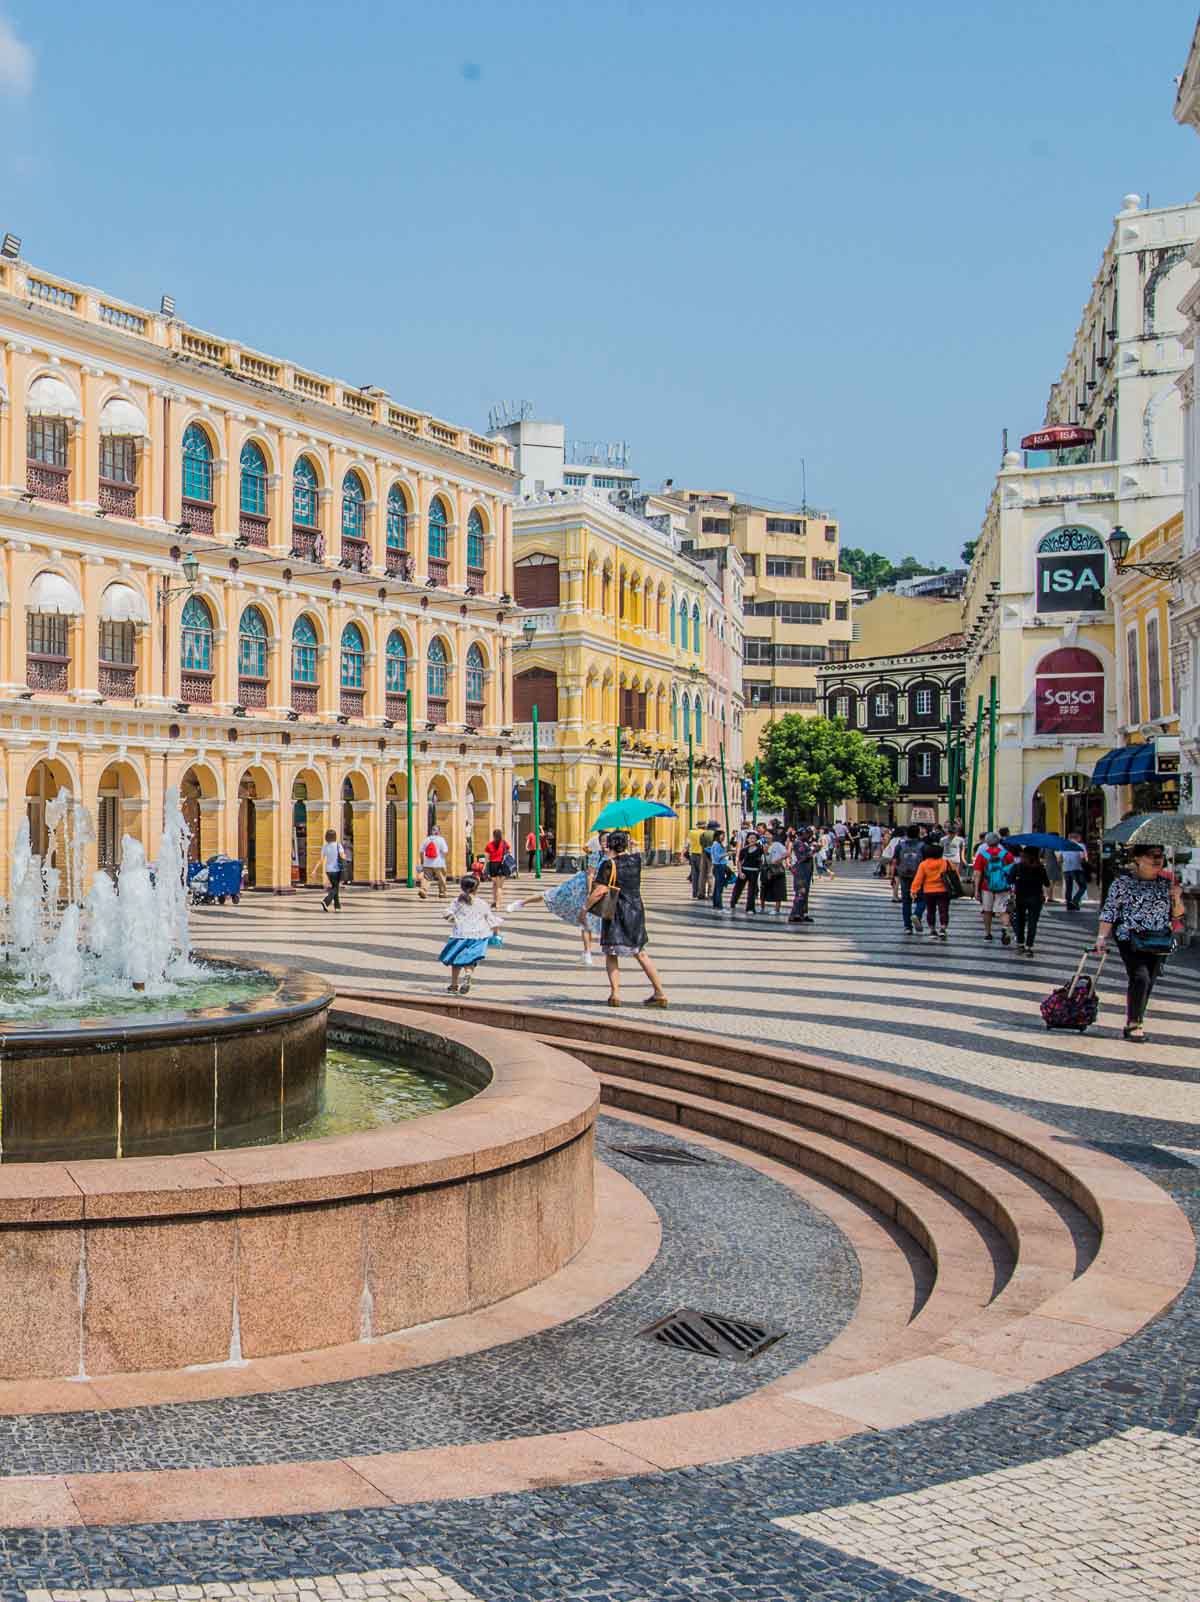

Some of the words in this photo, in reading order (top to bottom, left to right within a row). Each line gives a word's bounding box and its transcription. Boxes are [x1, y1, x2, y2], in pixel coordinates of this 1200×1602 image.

[1034, 434, 1050, 444] ISA
[1060, 431, 1078, 440] ISA
[1043, 567, 1101, 593] ISA
